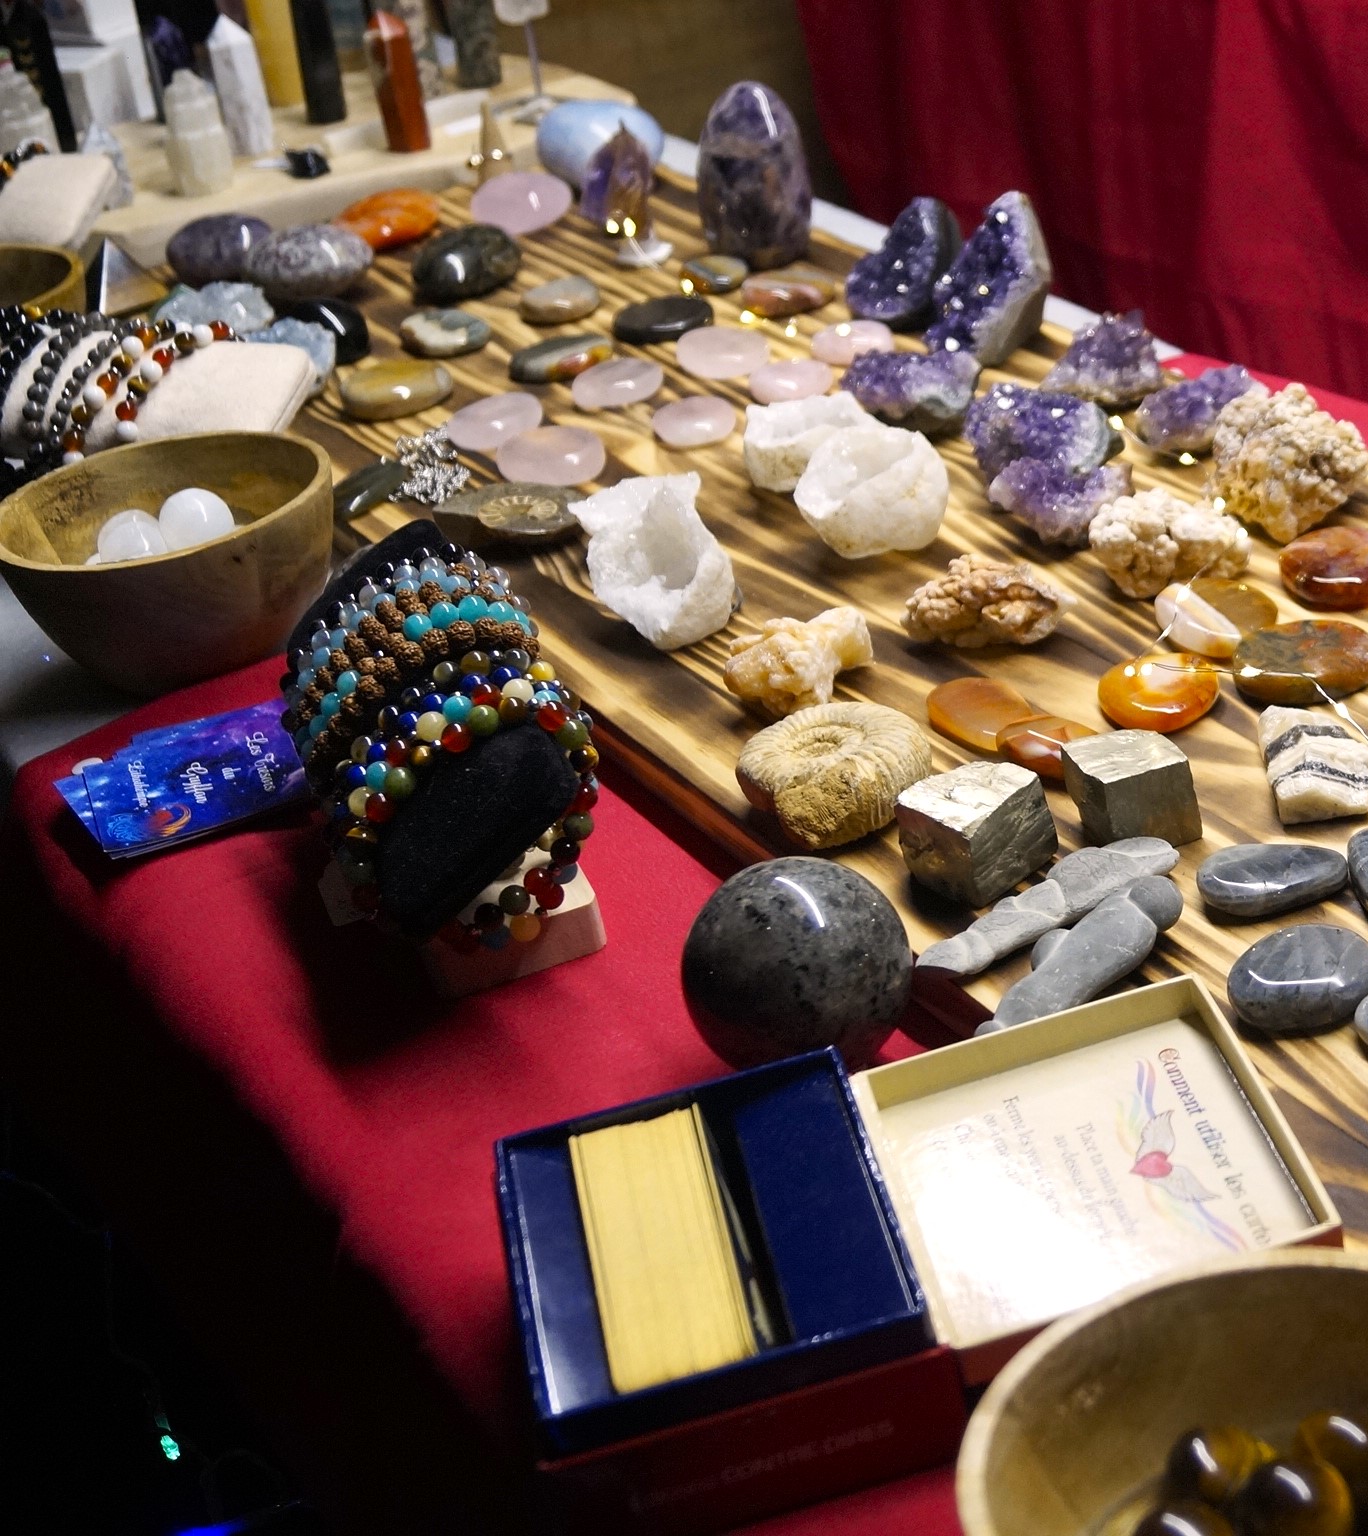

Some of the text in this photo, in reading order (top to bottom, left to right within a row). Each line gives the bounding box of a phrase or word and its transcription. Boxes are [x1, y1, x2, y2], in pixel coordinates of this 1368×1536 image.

[245, 731, 268, 756] Les
[179, 761, 214, 804] Gryffon
[221, 767, 241, 780] du
[1002, 1095, 1026, 1130] Ferme
[1075, 1121, 1099, 1152] Place
[1158, 1047, 1206, 1117] Comment
[1195, 1118, 1232, 1170] utiliser
[1239, 1202, 1272, 1249] carte
